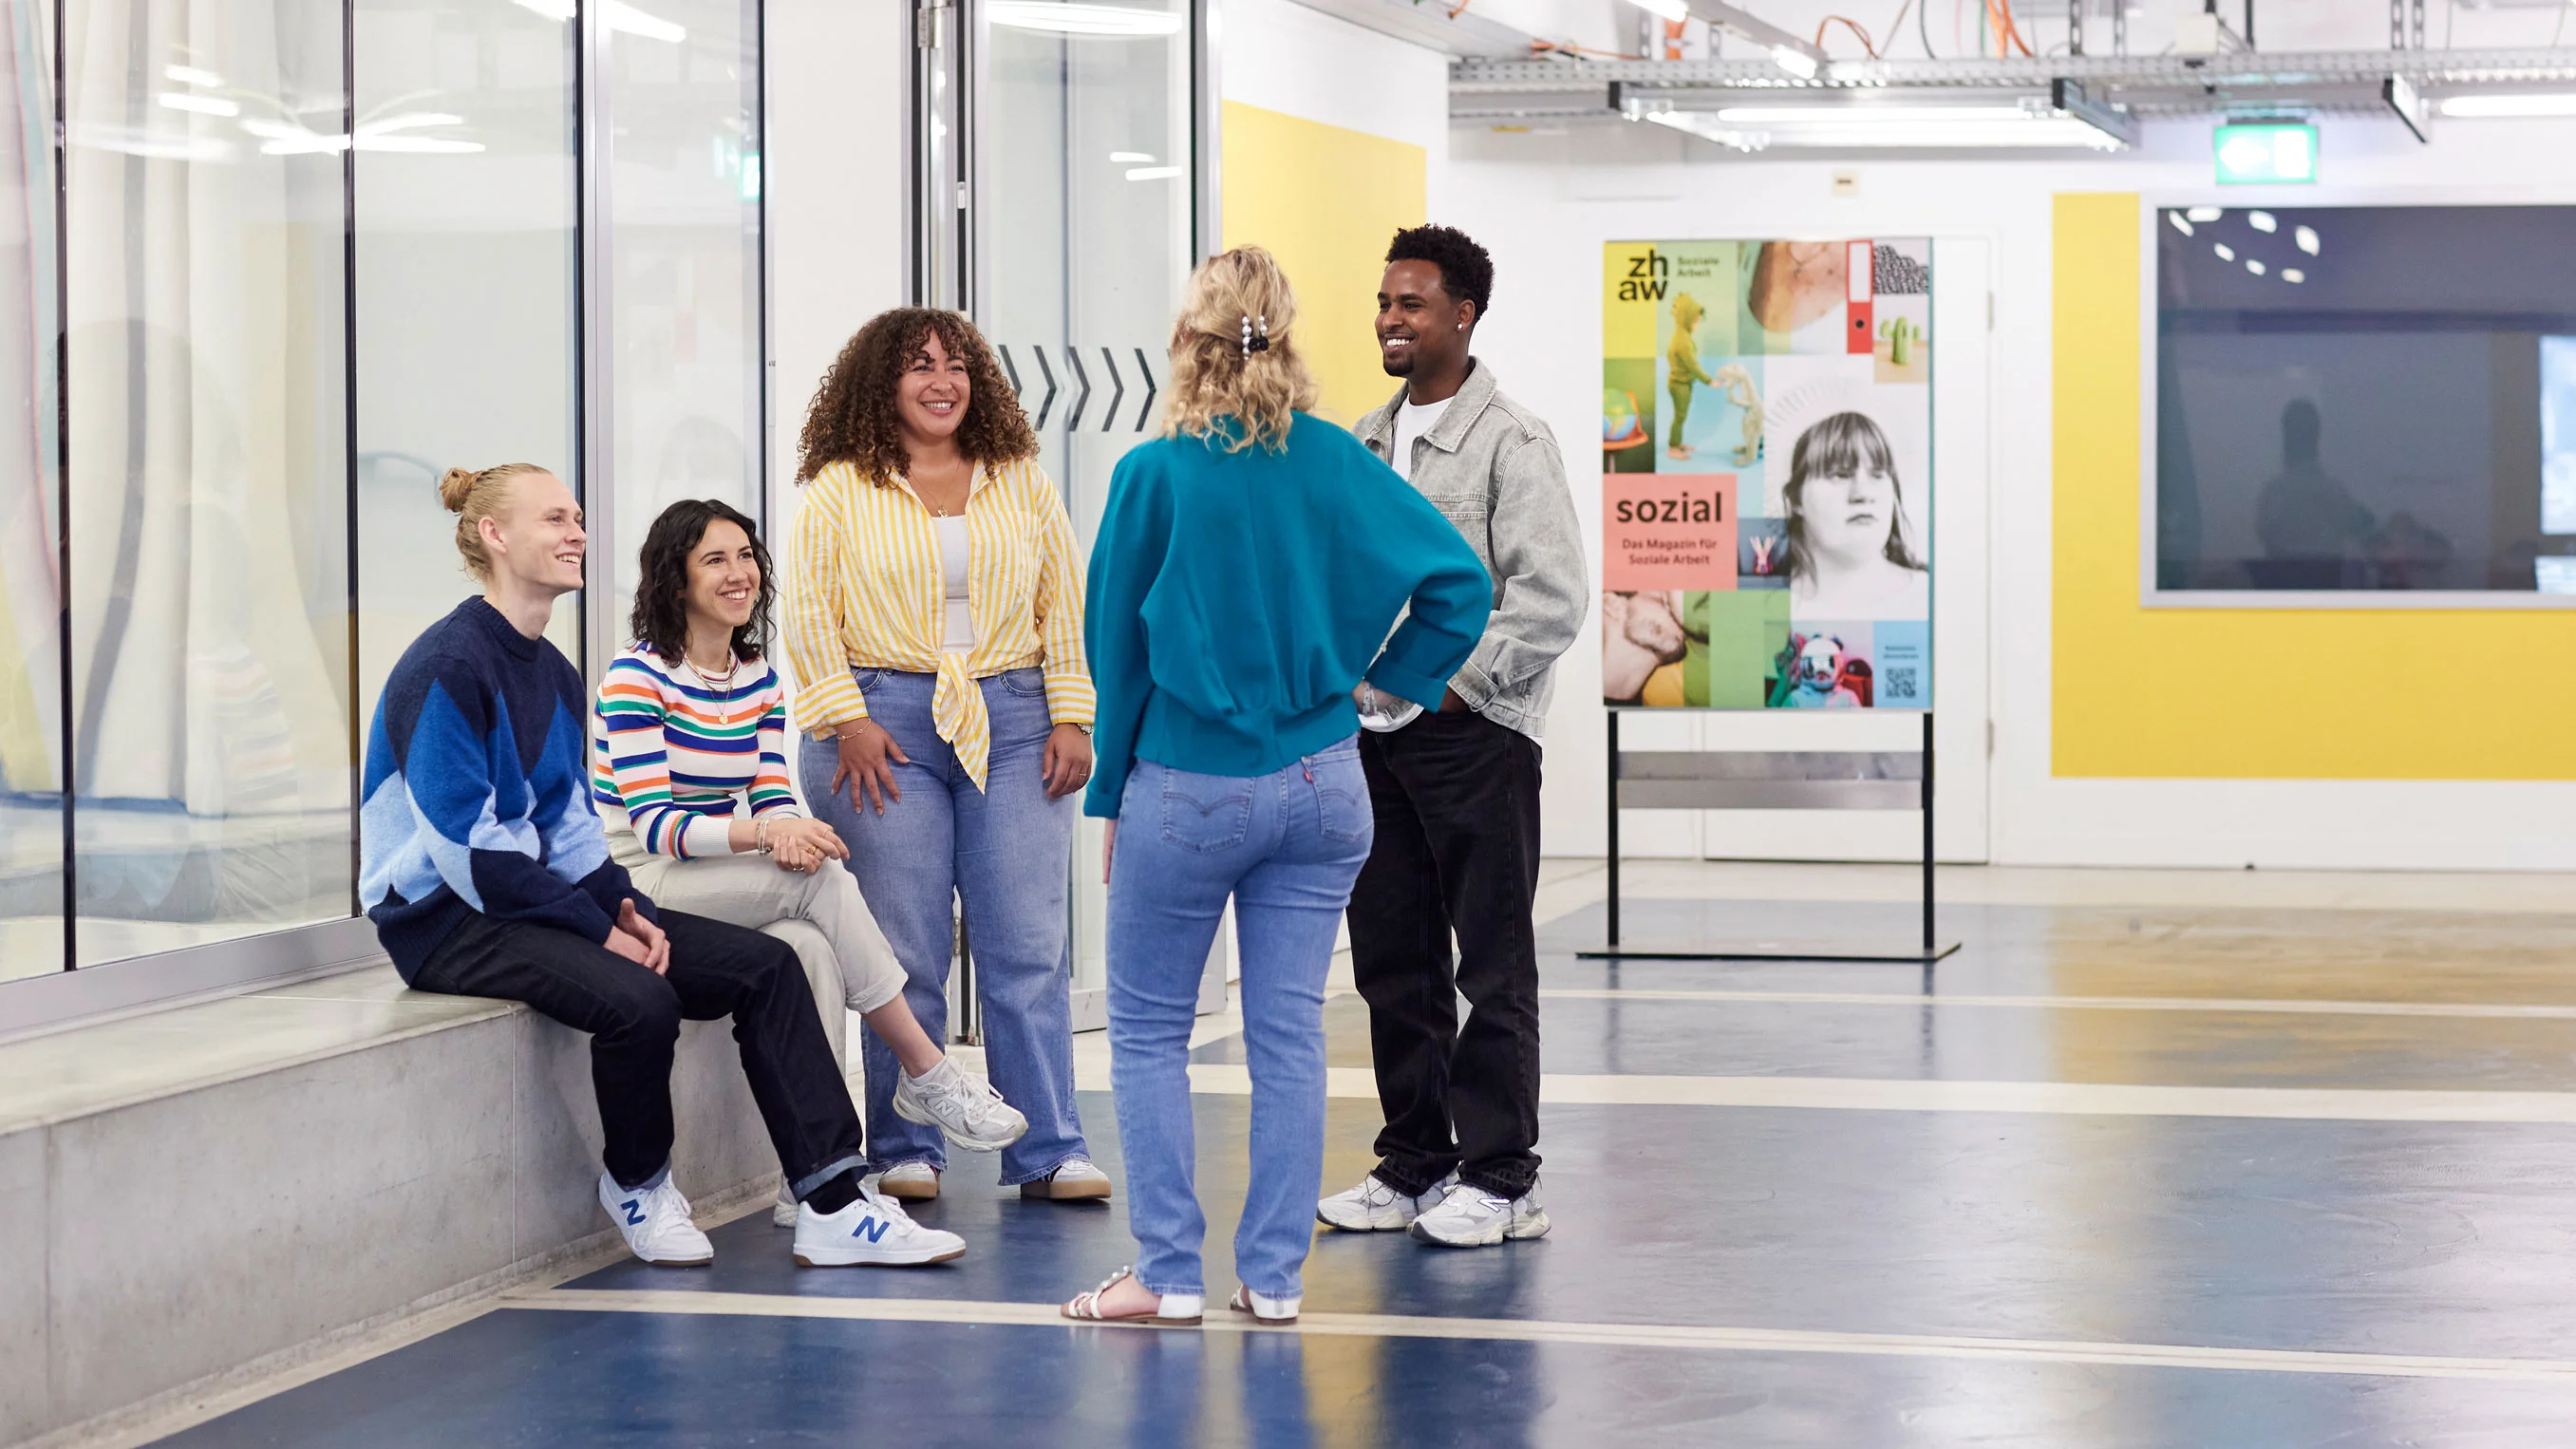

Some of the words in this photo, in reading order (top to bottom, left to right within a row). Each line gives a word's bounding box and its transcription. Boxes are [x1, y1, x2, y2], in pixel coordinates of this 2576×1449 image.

[1628, 249, 1668, 277] zh
[1618, 280, 1668, 302] aw
[1616, 492, 1722, 523] sozial
[1622, 538, 1644, 550] Das
[1646, 538, 1697, 553] Magazin
[1699, 538, 1717, 550] für
[1628, 554, 1670, 565] Soziale
[1672, 554, 1710, 565] Arbeit
[934, 1101, 956, 1118] N
[620, 1198, 647, 1226] N
[851, 1215, 891, 1244] N
